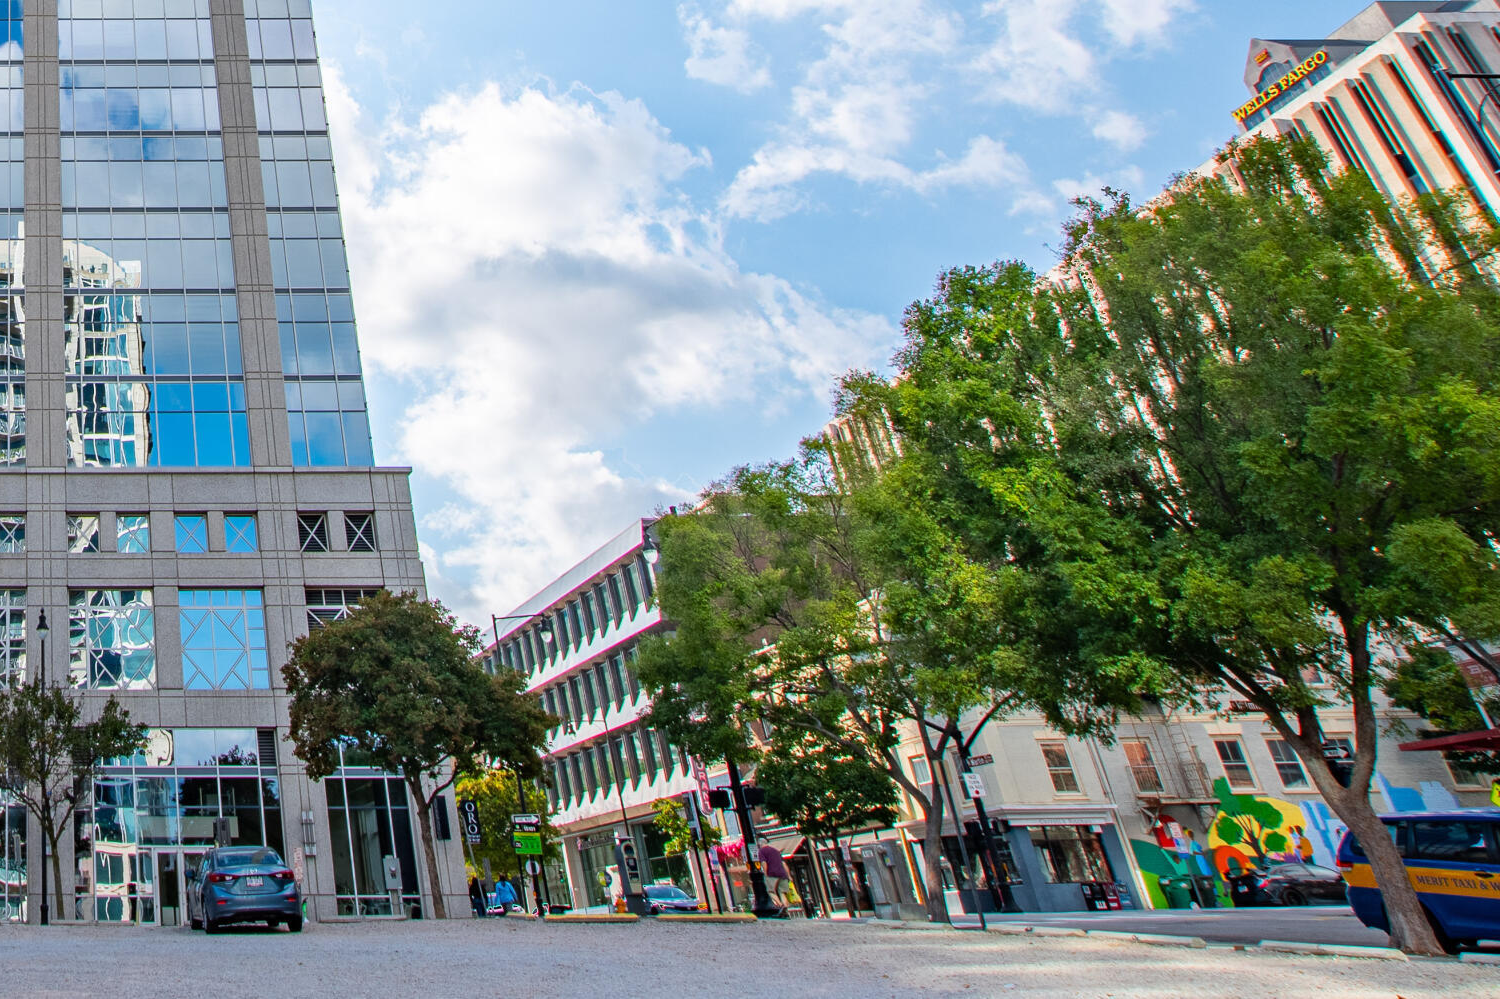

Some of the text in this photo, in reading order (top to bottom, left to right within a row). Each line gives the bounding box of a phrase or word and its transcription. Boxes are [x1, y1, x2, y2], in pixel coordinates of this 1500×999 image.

[1231, 50, 1328, 122] WELLS FARGO
[465, 801, 478, 834] ORO
[1415, 875, 1449, 887] MERIT
[1451, 877, 1477, 889] TAXI
[1480, 879, 1489, 890] &
